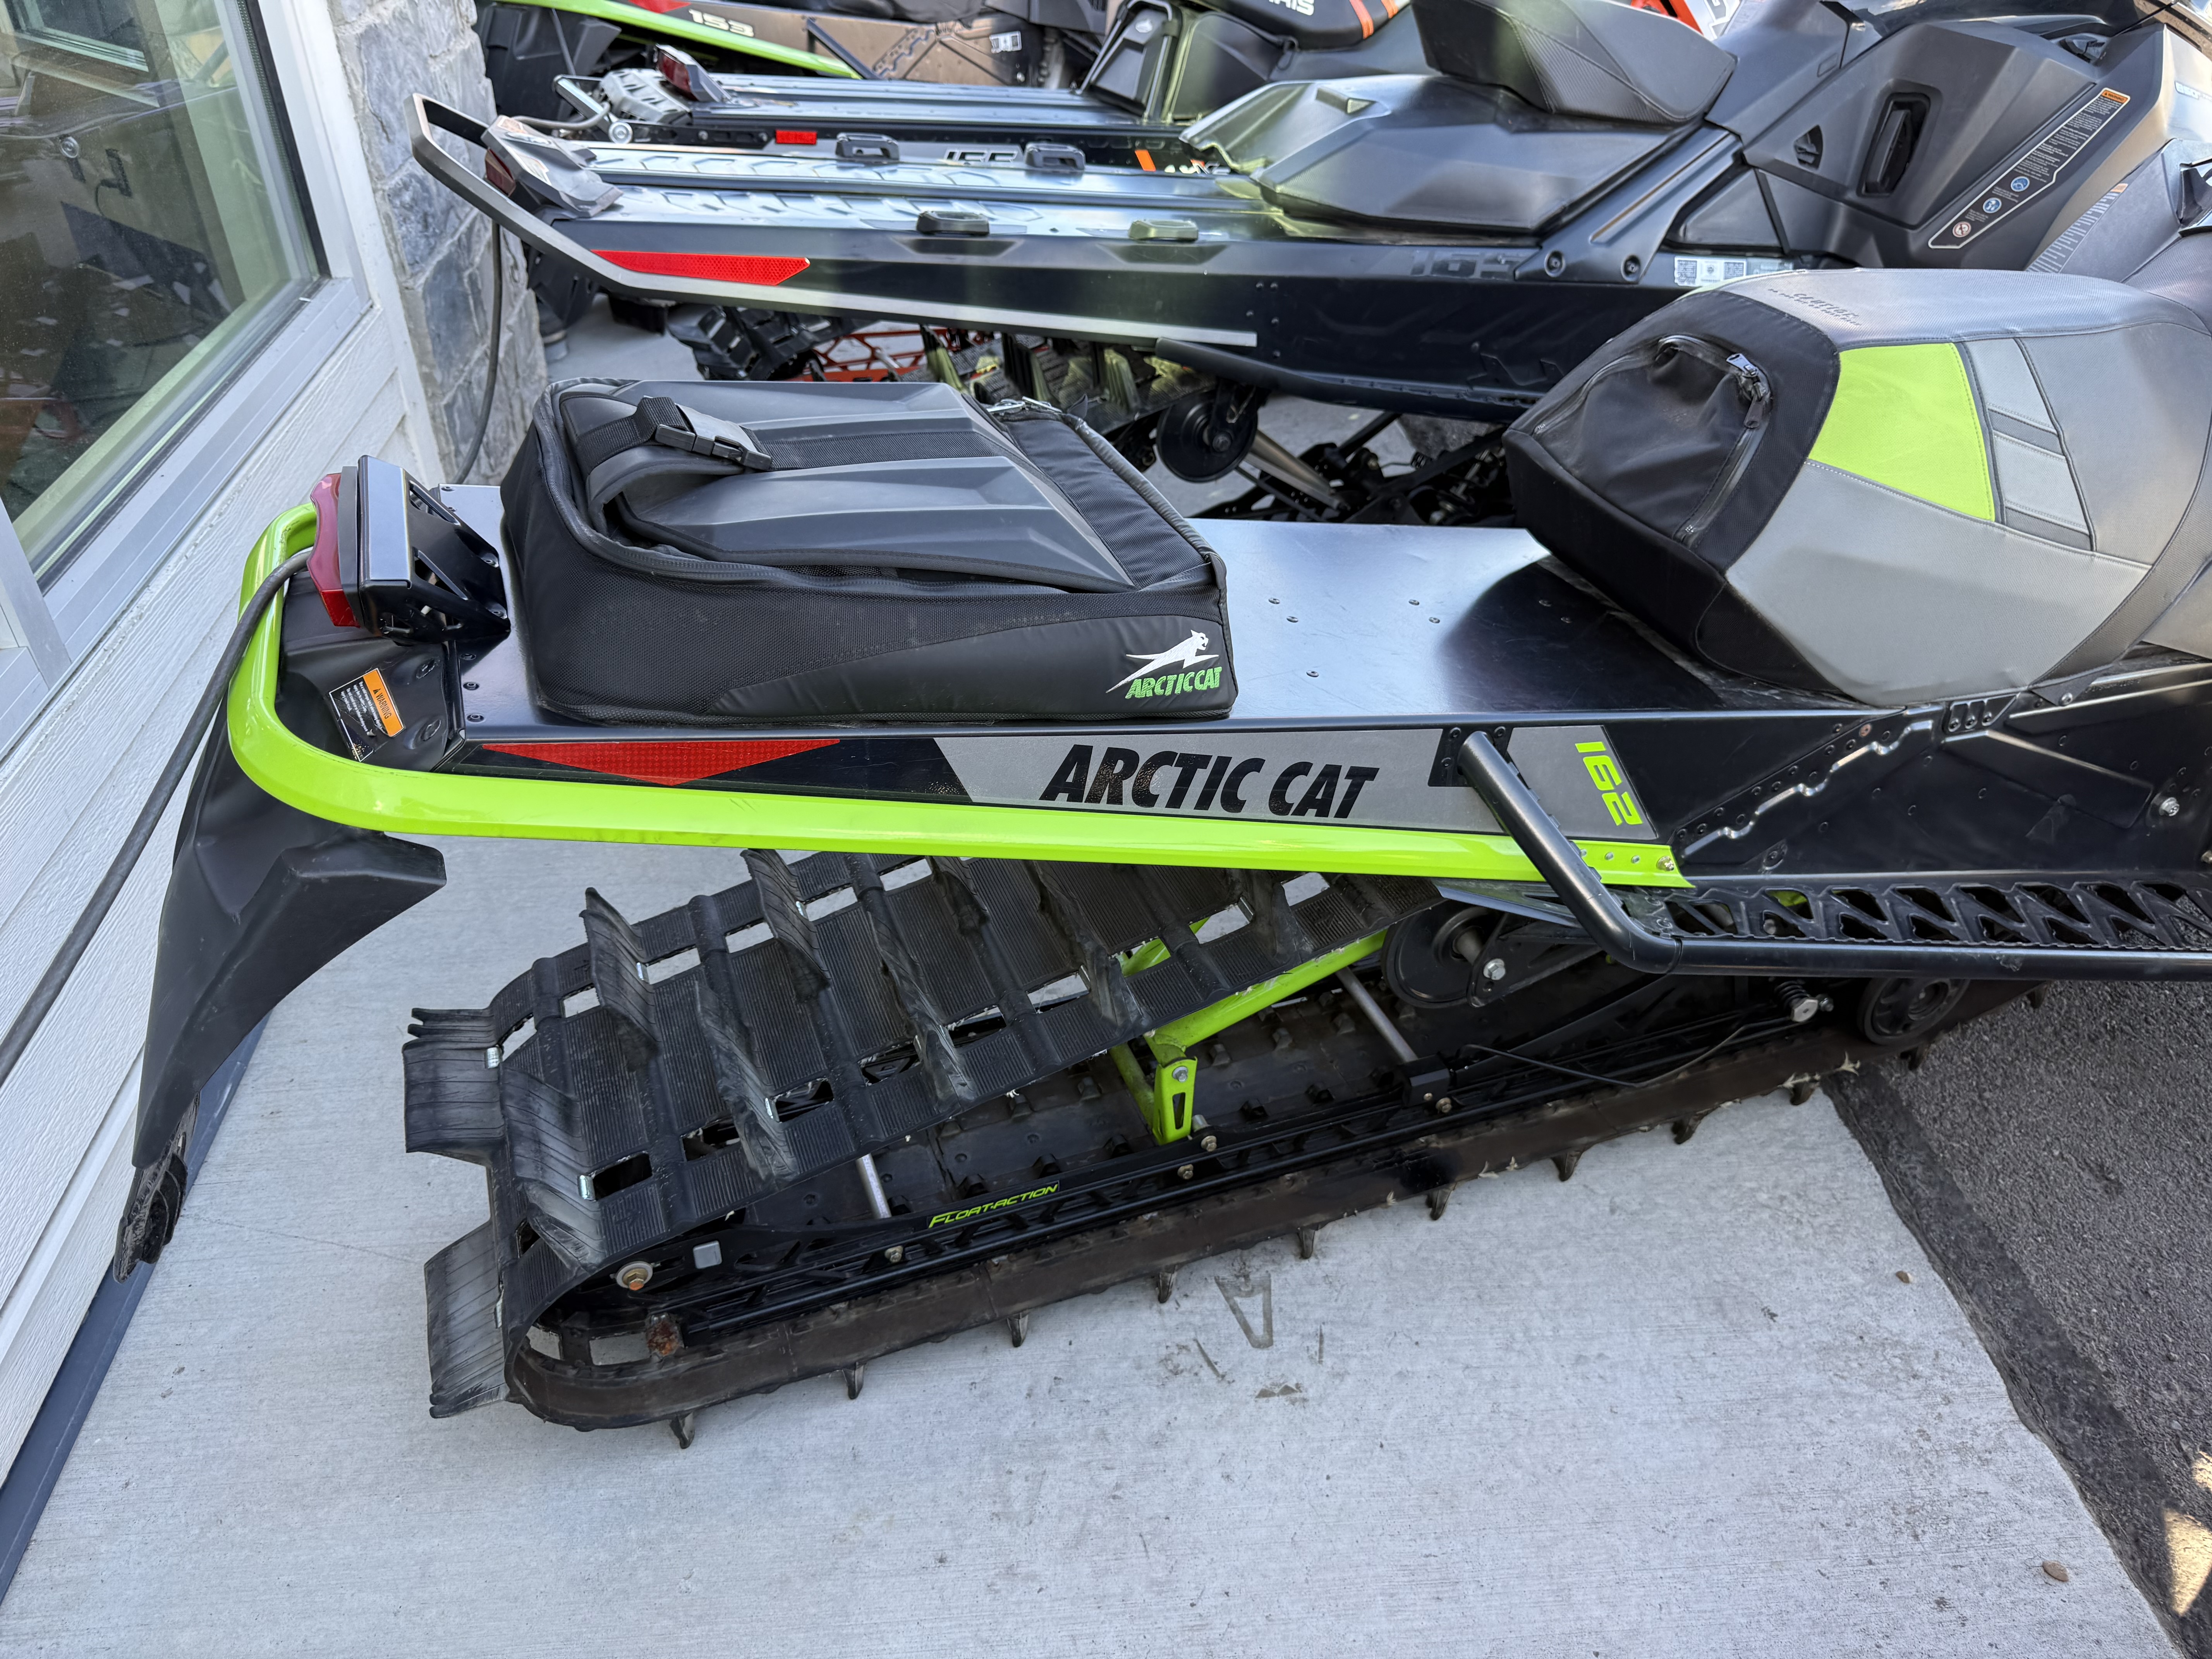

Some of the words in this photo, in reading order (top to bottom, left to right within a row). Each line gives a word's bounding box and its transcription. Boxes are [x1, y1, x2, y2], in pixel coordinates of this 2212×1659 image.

[688, 8, 754, 38] 153
[375, 692, 392, 719] WARNING
[1039, 744, 1266, 814] ARCTIC
[1268, 761, 1380, 819] CAT
[1575, 741, 1643, 826] 162
